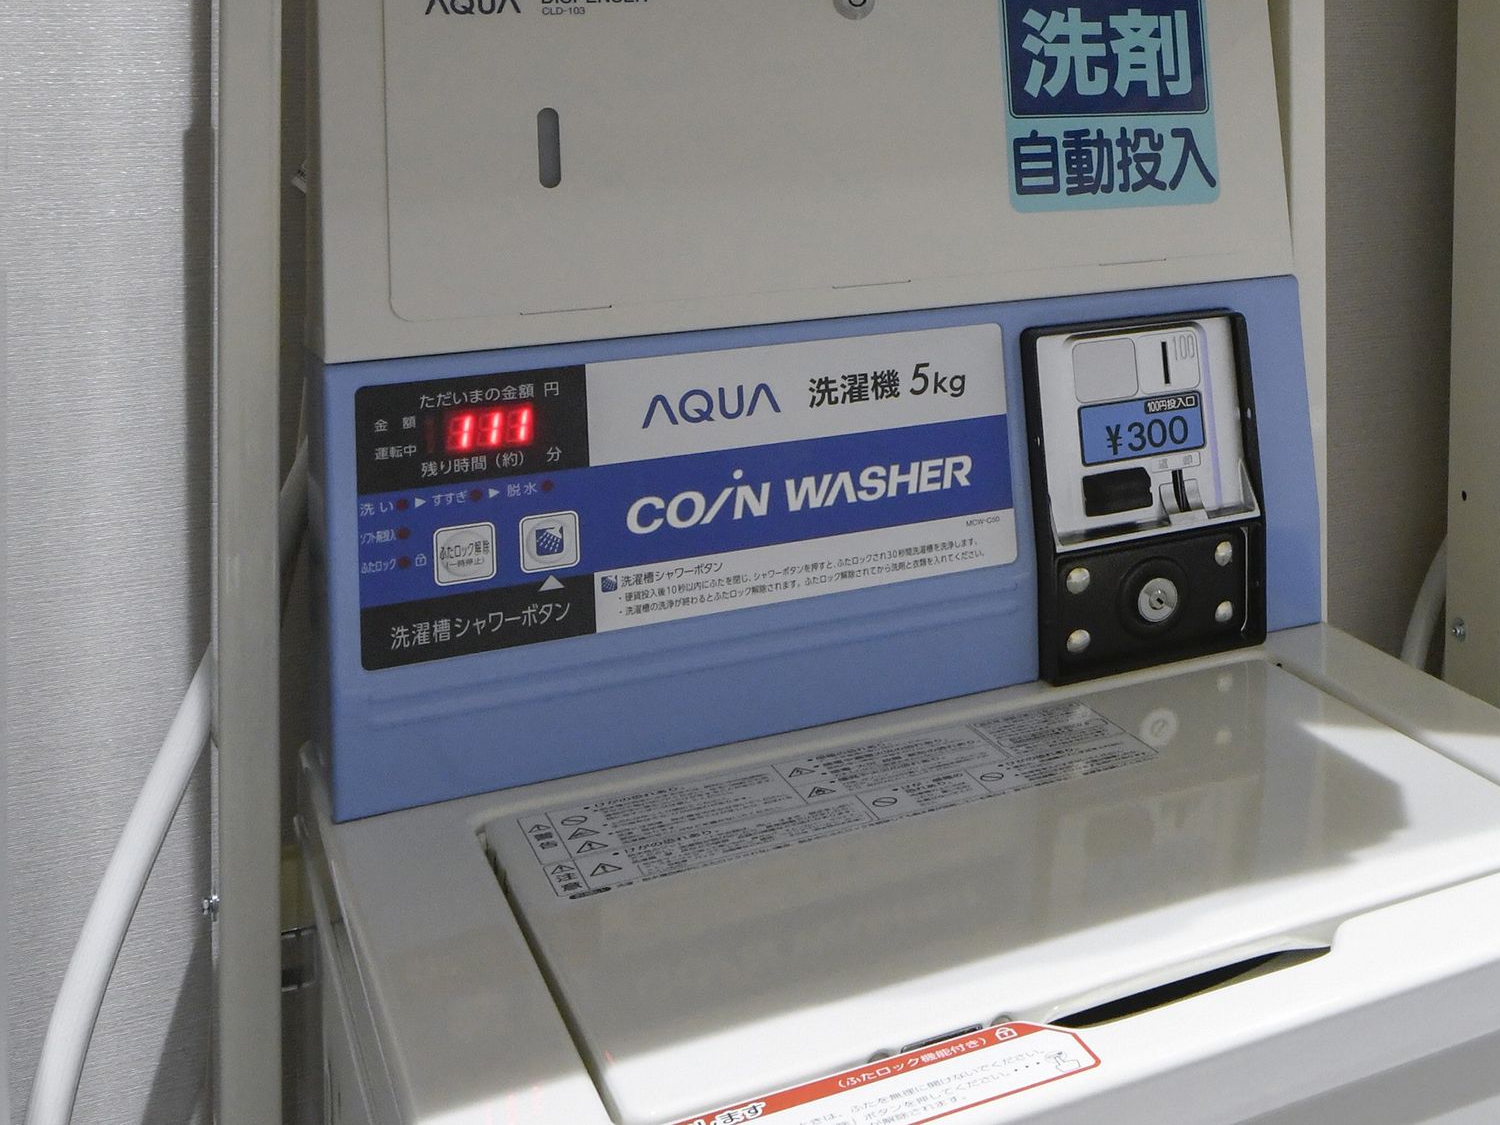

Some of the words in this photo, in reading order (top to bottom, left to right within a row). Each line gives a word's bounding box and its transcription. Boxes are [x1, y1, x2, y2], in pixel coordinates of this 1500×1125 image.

[542, 6, 586, 16] CLD-103
[1022, 7, 1193, 98] 洗剤
[1013, 127, 1217, 196] 自動投入
[419, 383, 534, 409] ただいまの金額
[544, 382, 560, 397] 円
[642, 382, 781, 429] AQUA
[809, 369, 900, 409] 洗濯機
[909, 362, 967, 398] 5kg
[1147, 396, 1195, 413] 100円投入口
[1106, 415, 1189, 455] ¥300
[374, 445, 417, 460] 運転中
[547, 446, 562, 463] 分
[360, 499, 394, 516] 洗い
[432, 490, 467, 507] すすぎ
[507, 483, 538, 498] 脱水
[625, 468, 770, 535] COIN
[785, 455, 973, 512] WASHER
[621, 562, 723, 588] 洗濯槽シャワーボタン
[391, 602, 571, 650] 洗濯槽シャワーボタン
